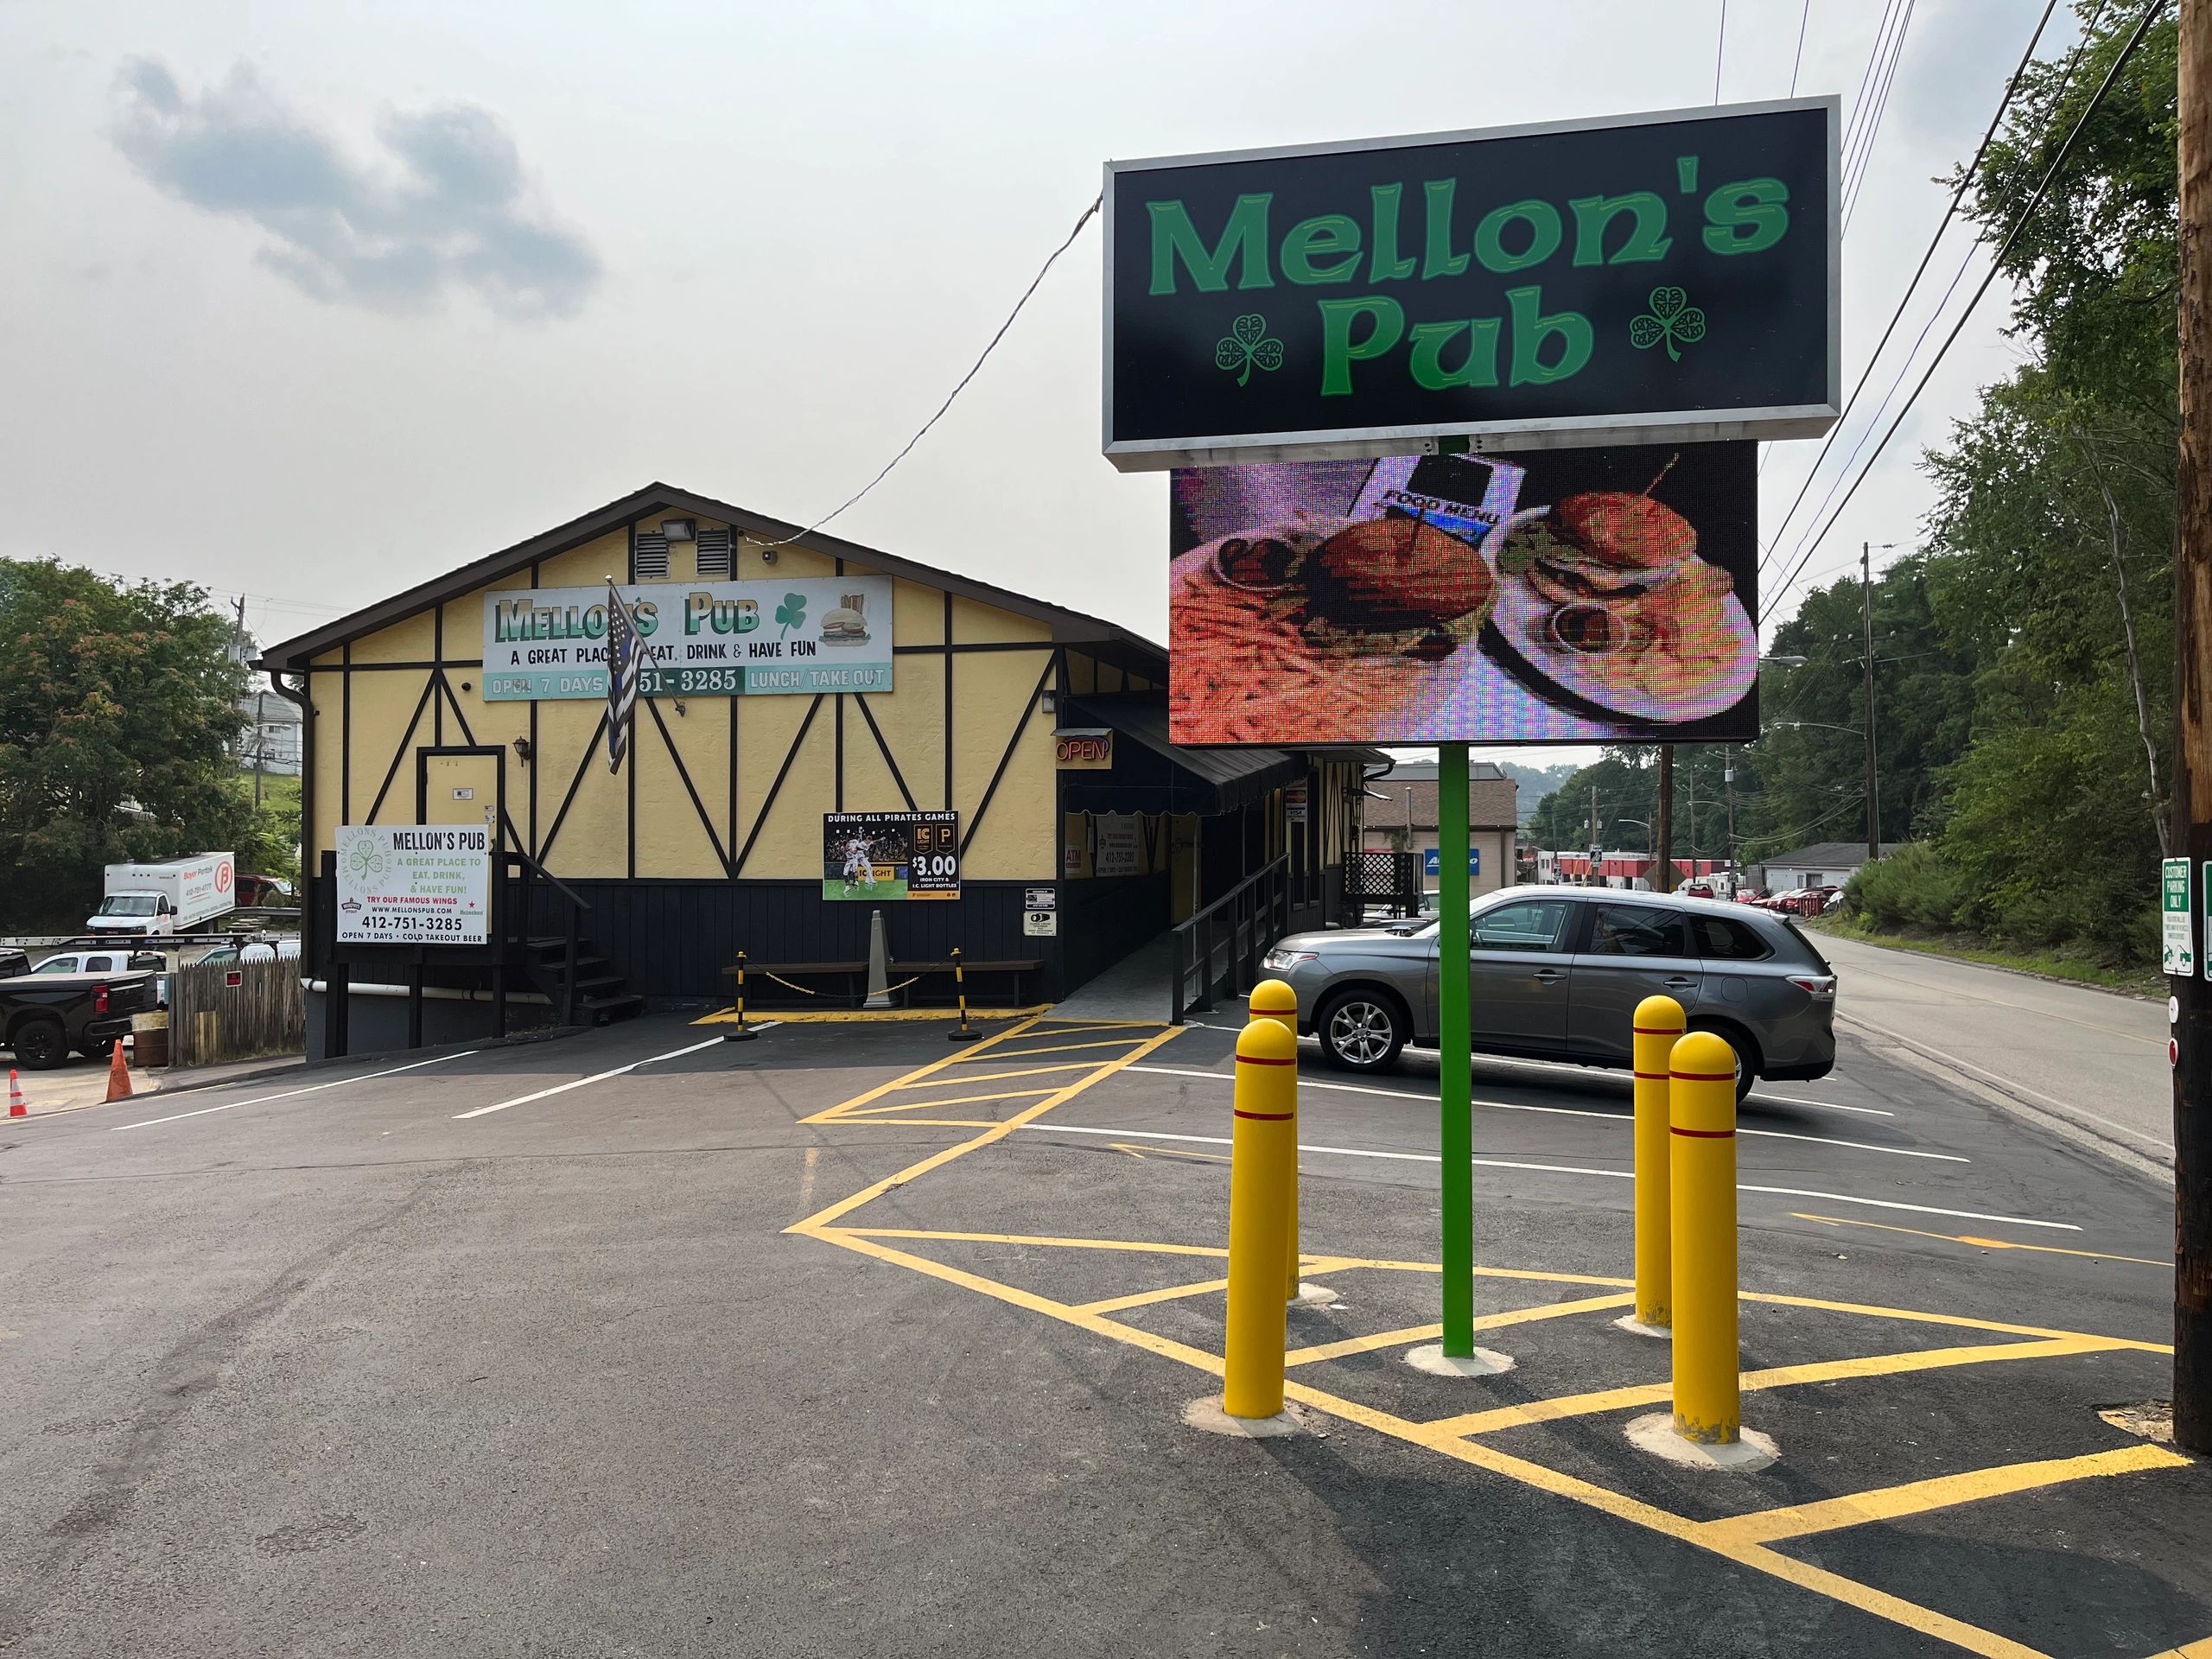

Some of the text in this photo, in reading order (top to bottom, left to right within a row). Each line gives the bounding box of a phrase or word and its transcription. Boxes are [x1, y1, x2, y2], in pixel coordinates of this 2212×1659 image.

[1145, 155, 1790, 296] Mellon's
[1318, 285, 1594, 397] Pub
[1382, 489, 1500, 524] FOOD MENU
[511, 651, 520, 665] A
[528, 648, 568, 664] GREAT
[576, 647, 608, 663] PLAC
[687, 643, 728, 659] DRINK
[733, 643, 742, 658] &
[748, 642, 782, 658] HAVE
[791, 640, 817, 657] FUN
[853, 669, 885, 686] OUT
[492, 677, 604, 695] OPEN 7 DAYS
[1056, 741, 1106, 760] OPEN
[884, 813, 922, 822] PIRATES
[925, 812, 956, 821] GAMES
[393, 831, 486, 851] MELLON'S PUB
[397, 857, 481, 867] A GREAT PLACE TO
[1065, 850, 1081, 862] ATM
[912, 855, 957, 876] $3.00
[2164, 865, 2187, 879] CUSTOMER
[412, 871, 465, 880] EAT, DRINK,
[445, 886, 467, 894] FUN!
[2166, 880, 2185, 893] PARKING
[2170, 894, 2182, 908] ONLY
[362, 916, 462, 931] 412-751-3285
